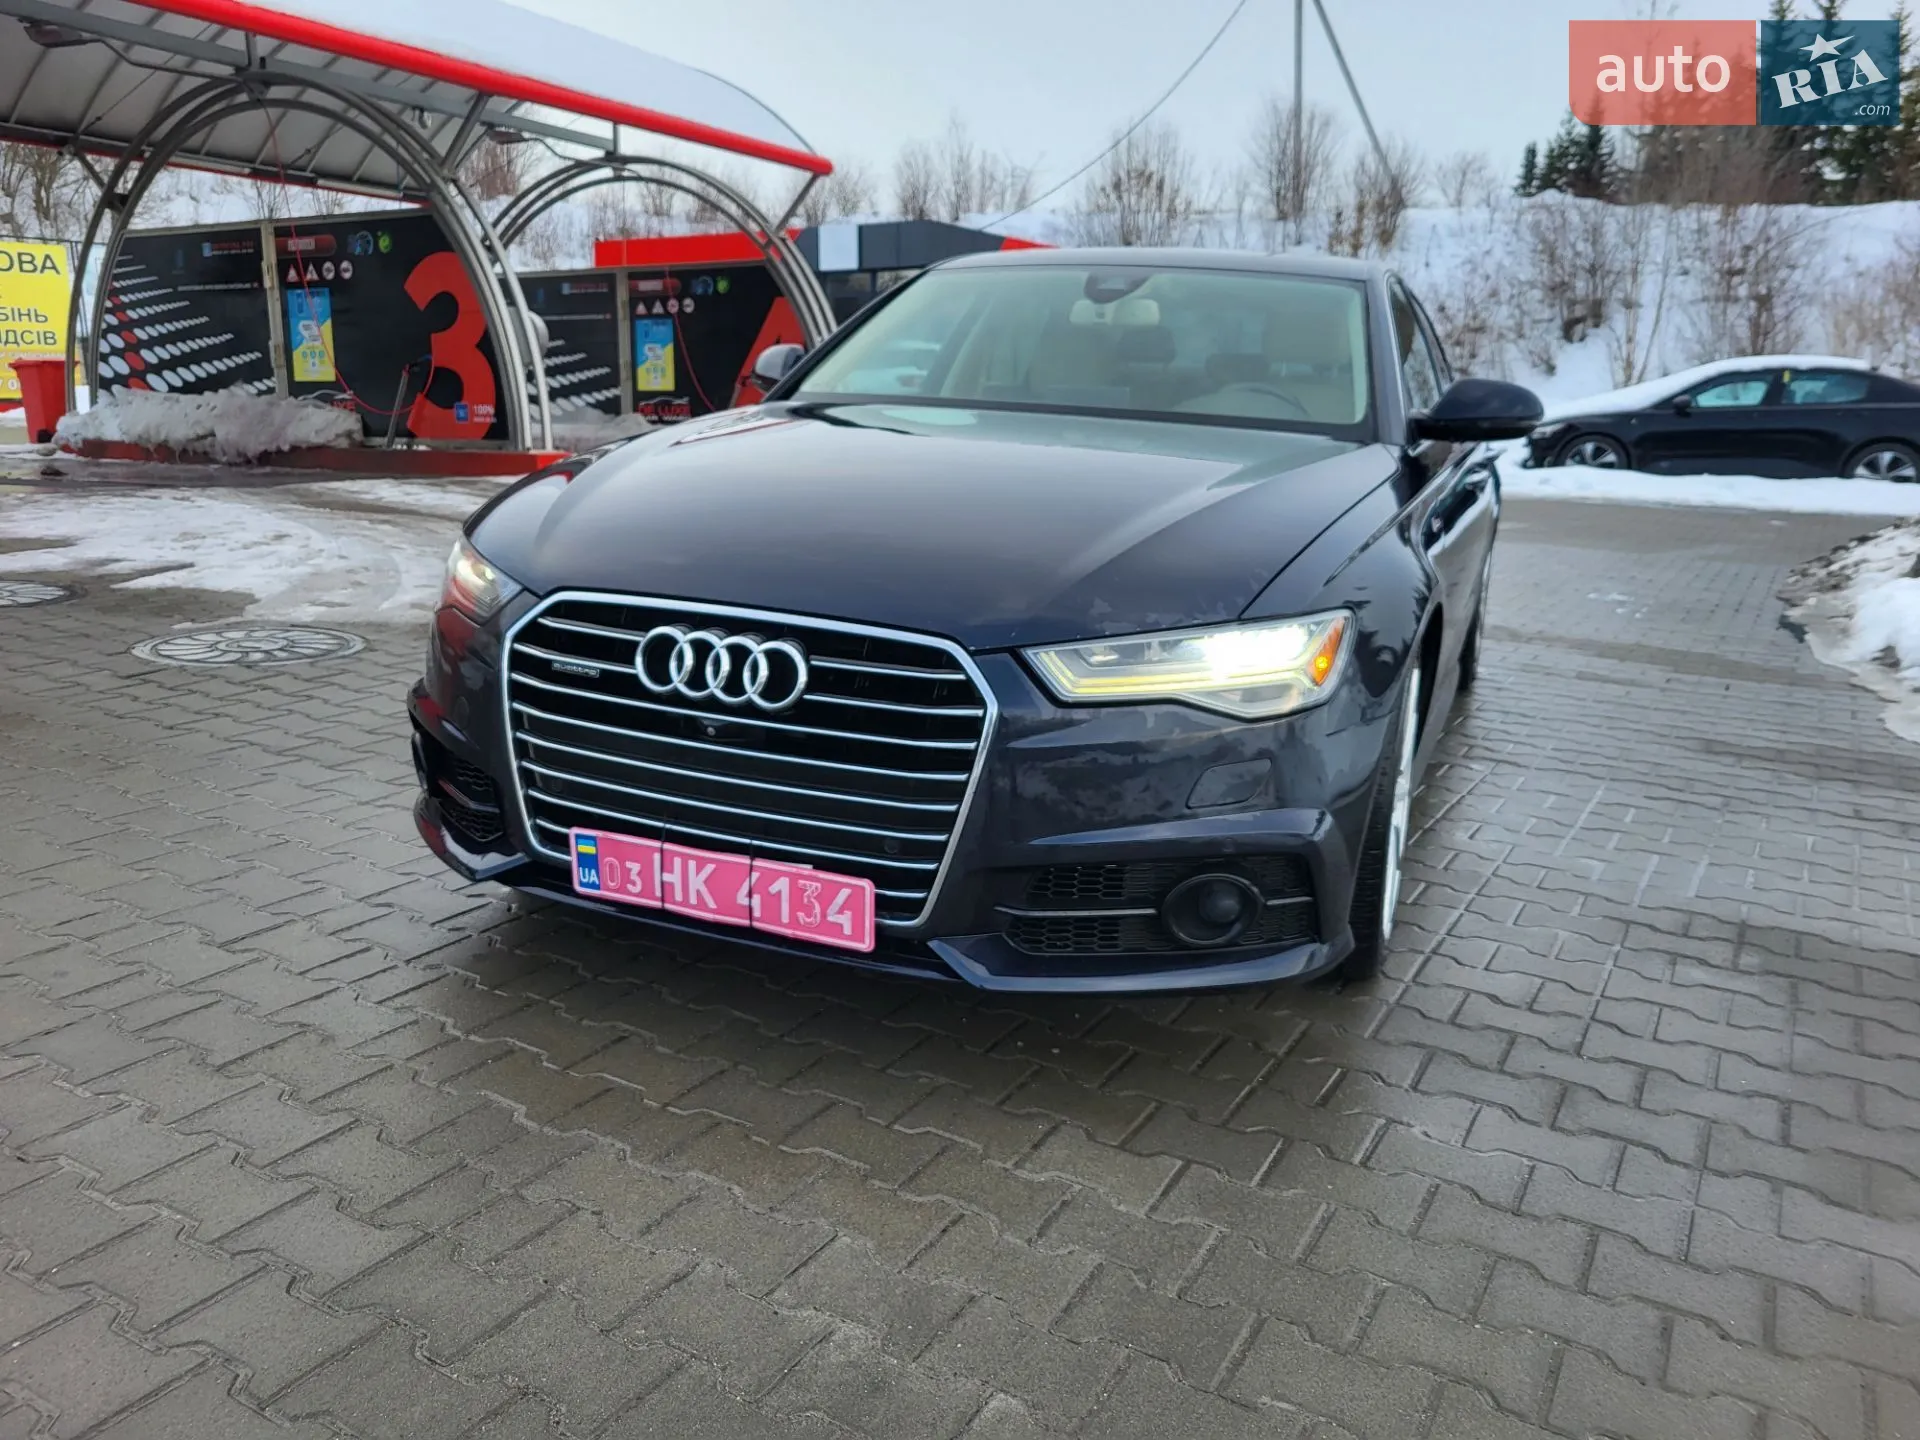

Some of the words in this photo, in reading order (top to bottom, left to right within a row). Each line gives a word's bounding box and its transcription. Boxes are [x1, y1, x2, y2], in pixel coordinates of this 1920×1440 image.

[404, 251, 496, 440] 3
[580, 867, 599, 885] UA
[603, 857, 642, 893] 03
[653, 852, 717, 909] HK
[736, 872, 853, 935] 4134
